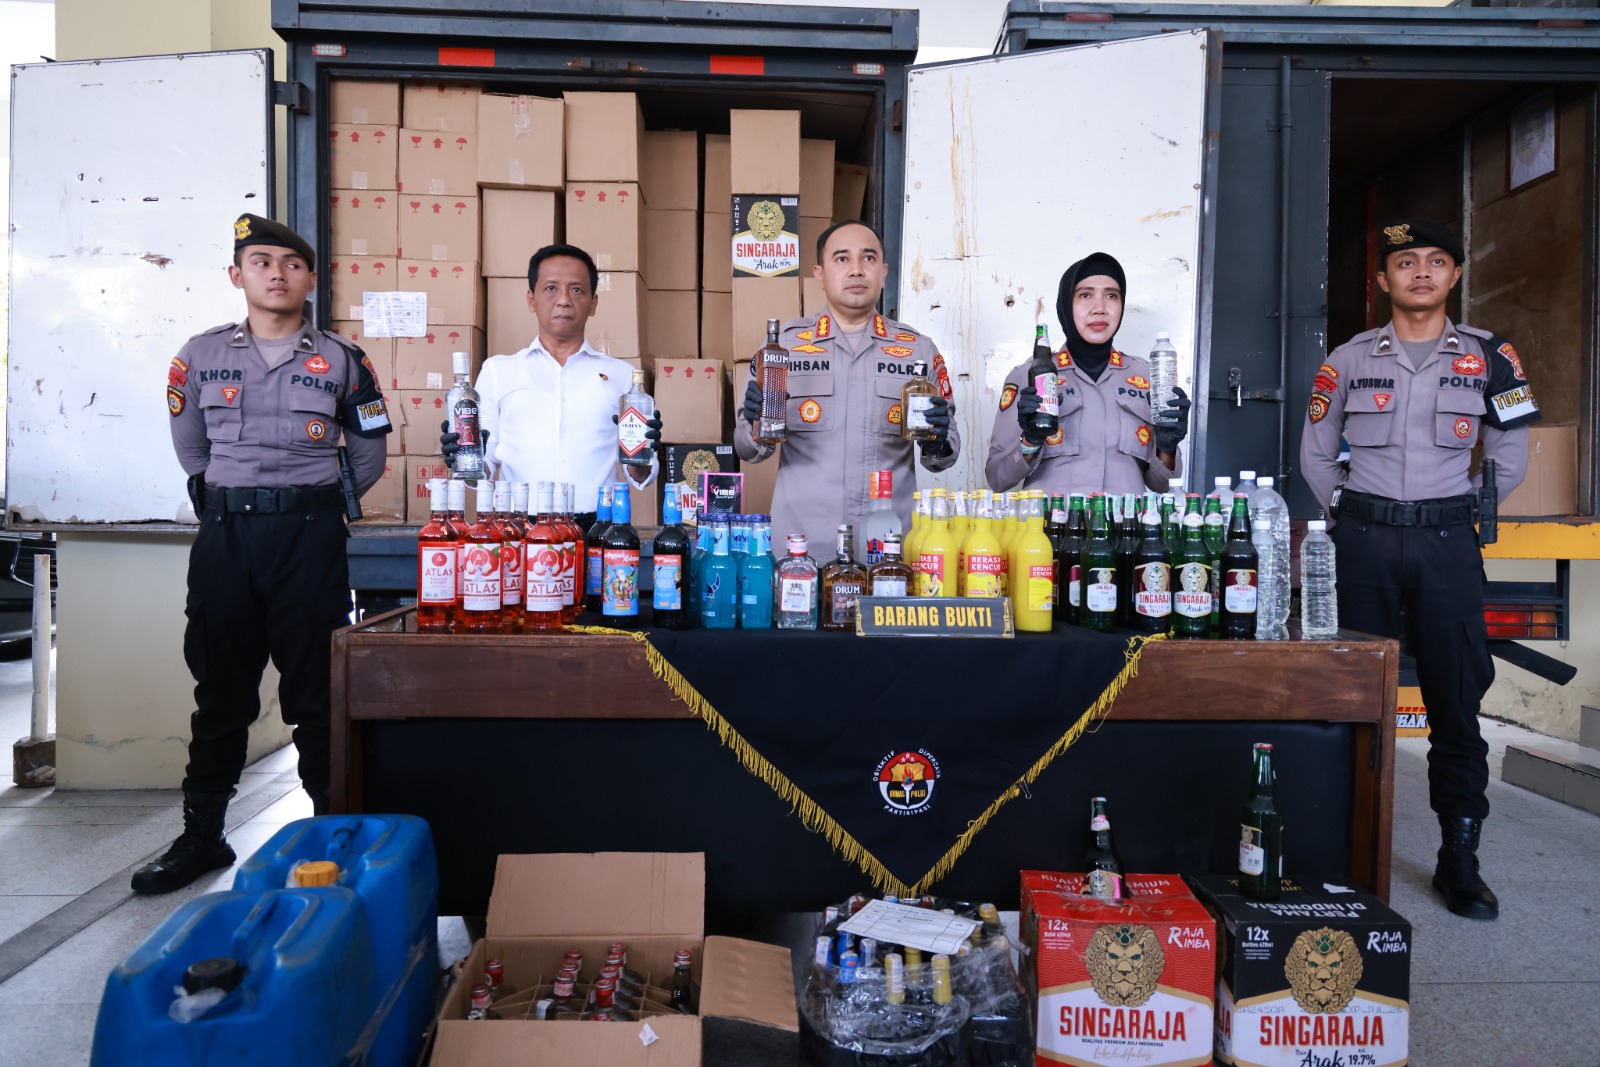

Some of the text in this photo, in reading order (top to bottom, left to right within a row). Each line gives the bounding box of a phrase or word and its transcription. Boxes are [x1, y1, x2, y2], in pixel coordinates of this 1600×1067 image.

[736, 243, 797, 258] SINGARAJA
[755, 258, 780, 271] Arak
[763, 353, 789, 364] DRUM
[789, 360, 830, 371] IHSAN
[878, 362, 915, 376] POLR
[200, 369, 242, 382] KHOR
[291, 374, 339, 394] POLRI
[1440, 377, 1487, 391] POLRI
[1118, 387, 1146, 399] POL
[1494, 387, 1532, 411] TURJ
[359, 401, 387, 420] TURJ
[425, 568, 453, 577] ATLAS
[465, 583, 498, 594] ATLAS
[504, 578, 520, 588] LAS
[531, 583, 563, 594] ATLAS
[835, 586, 861, 594] DRUM
[874, 605, 992, 628] BARANG BUKTI
[1396, 714, 1428, 728] BAK
[872, 750, 895, 782] OBYEKTIF
[918, 748, 942, 779] DIPERCAYA
[911, 788, 926, 798] POLRI
[883, 804, 931, 816] PARTISIPASI
[1041, 873, 1083, 886] KUALI
[1245, 901, 1368, 911] DI INDONESIA
[1270, 909, 1361, 918] PERTAMA
[1047, 919, 1069, 931] 12x
[1246, 926, 1270, 941] 12x
[1059, 1005, 1187, 1042] SINGARAJA
[1259, 1015, 1385, 1047] SINGARAJA
[1300, 1049, 1346, 1067] Arak
[1348, 1054, 1376, 1066] 19.7%
